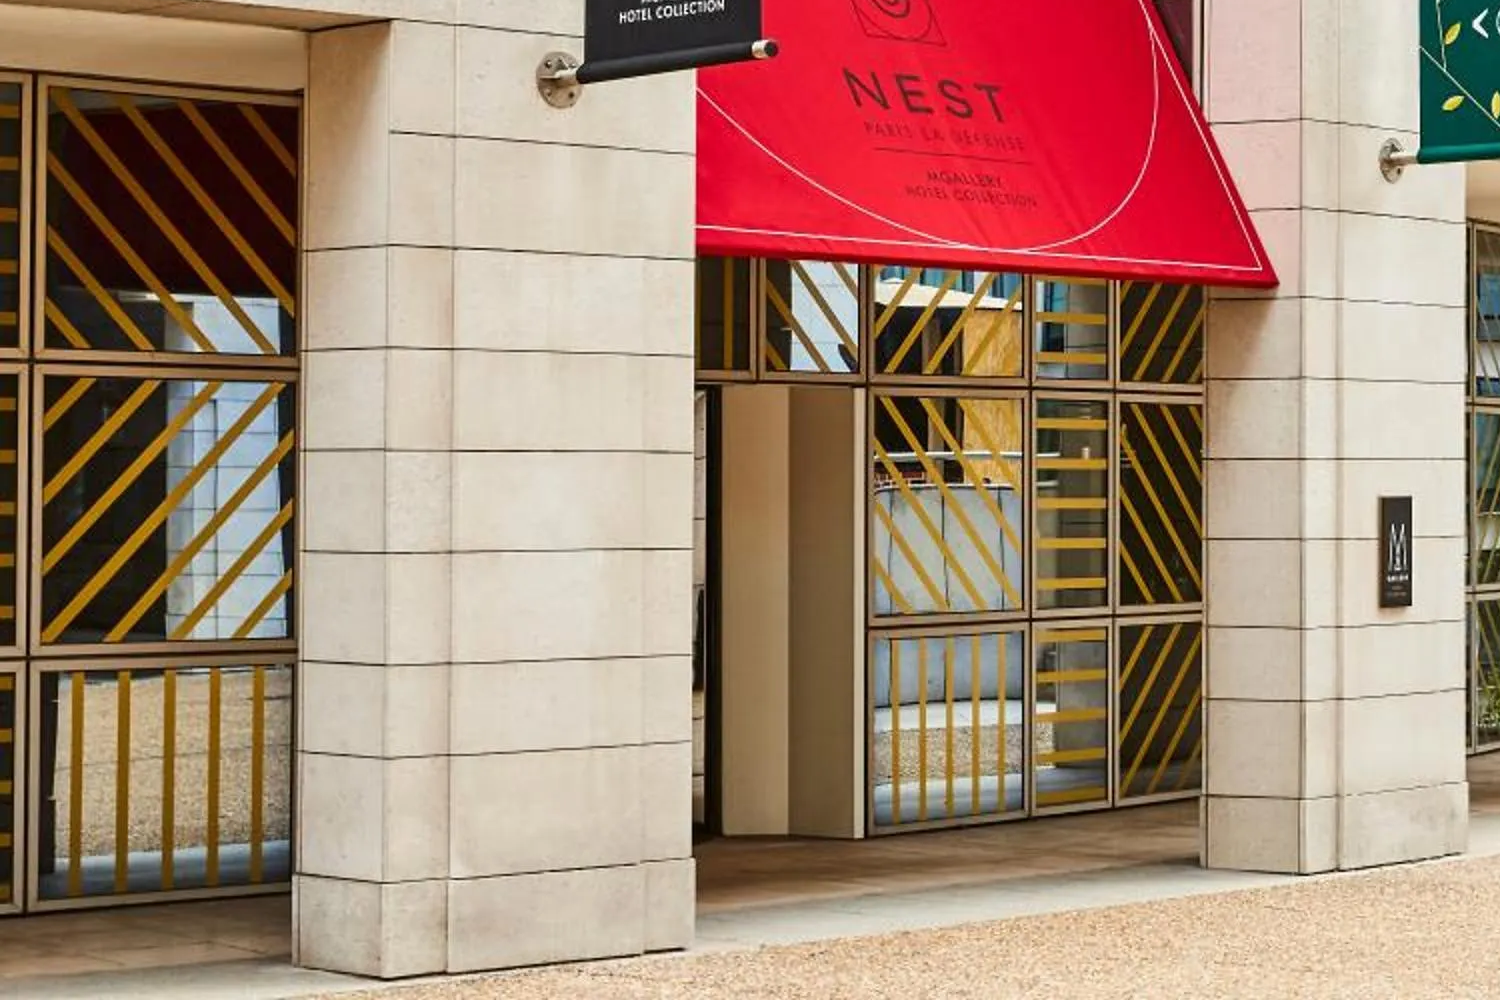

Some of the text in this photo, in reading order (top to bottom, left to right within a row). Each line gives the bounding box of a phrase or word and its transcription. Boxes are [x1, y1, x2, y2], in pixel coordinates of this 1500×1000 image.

[619, 8, 652, 25] HOTEL
[842, 66, 1005, 123] NEST
[863, 121, 913, 139] PARIS
[921, 126, 945, 142] LA
